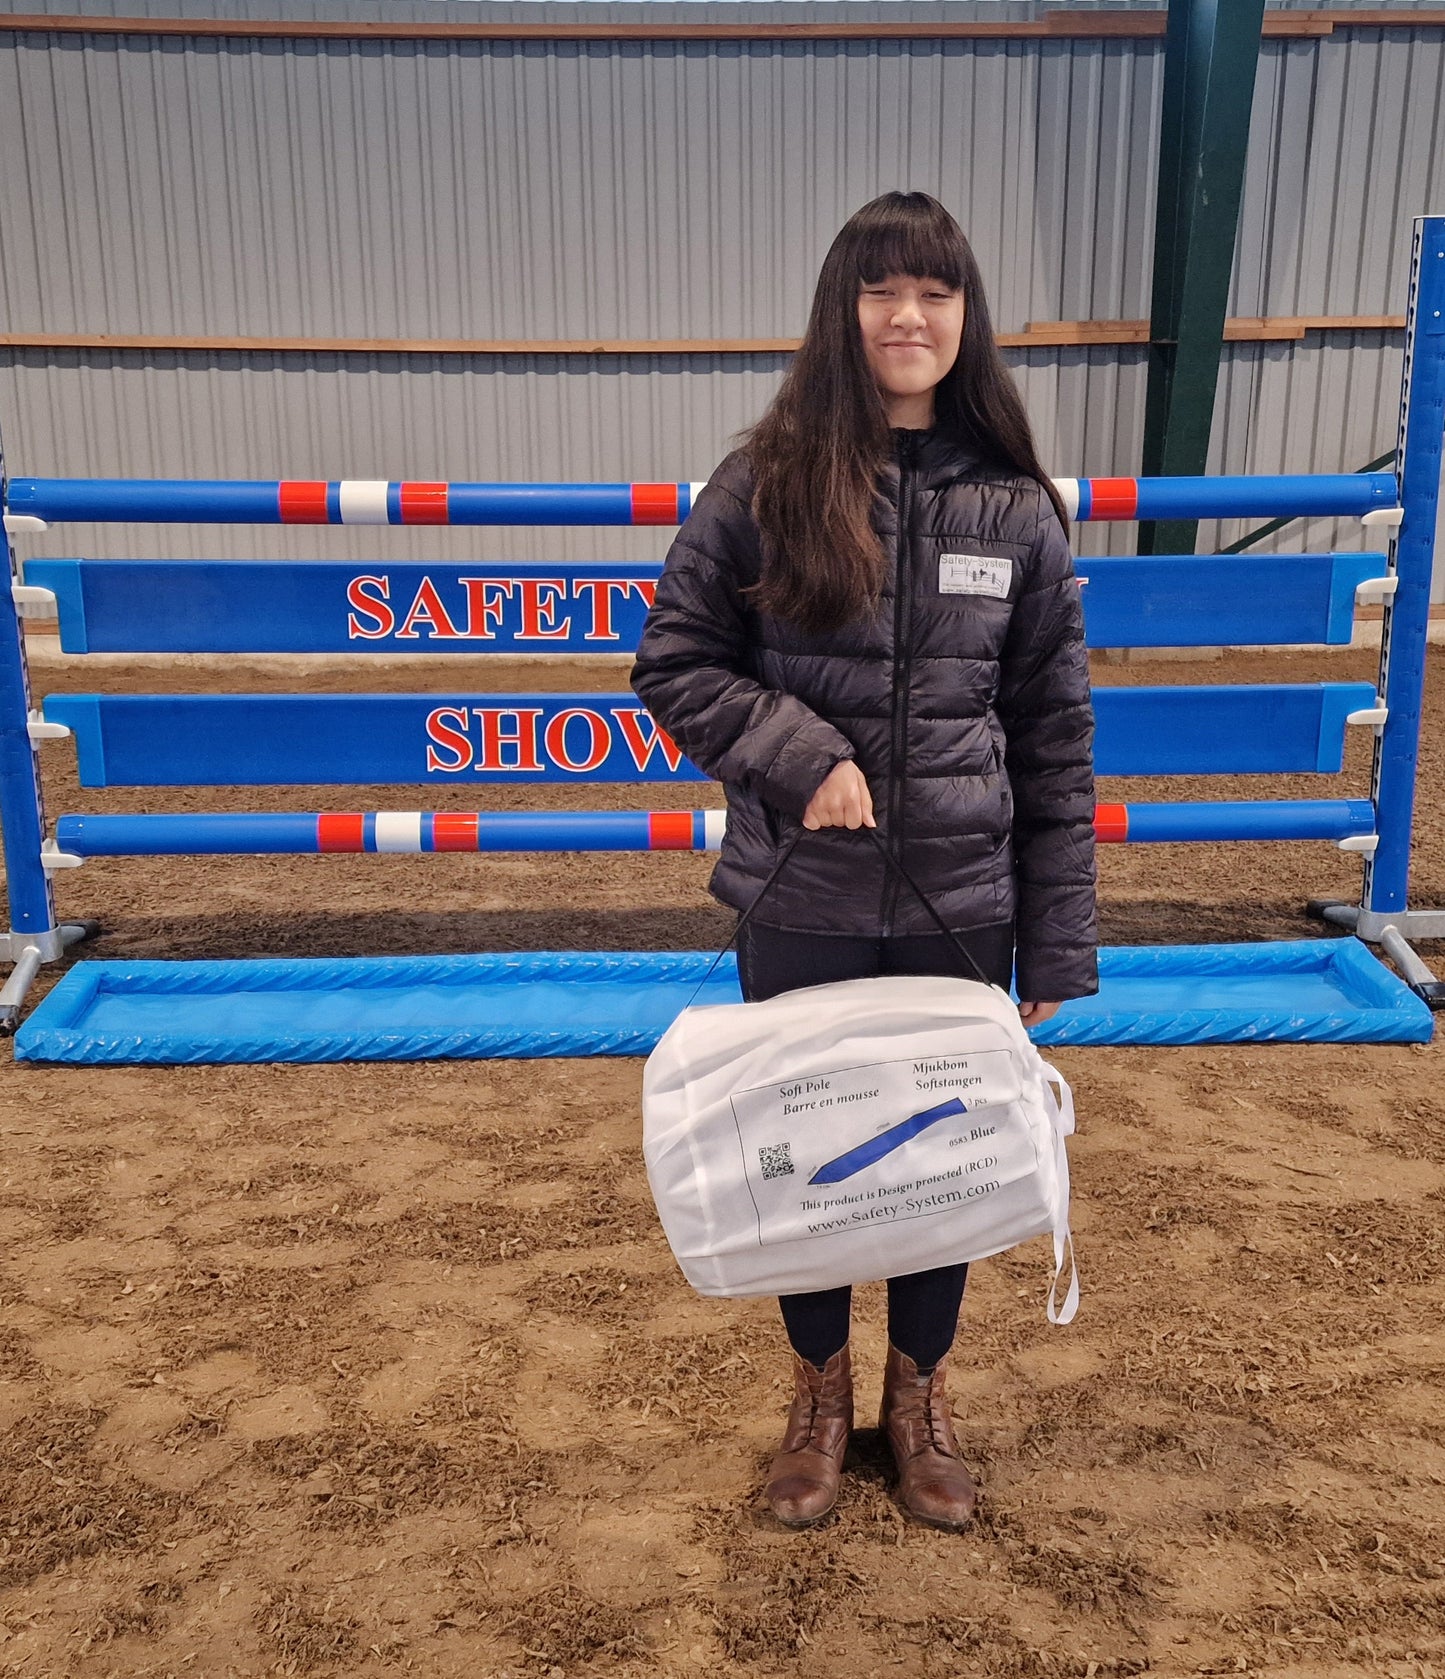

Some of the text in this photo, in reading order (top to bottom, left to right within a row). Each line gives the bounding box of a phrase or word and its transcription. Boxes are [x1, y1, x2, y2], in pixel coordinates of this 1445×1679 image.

[913, 1060, 968, 1076] Mjukbom
[779, 1079, 831, 1099] Soft Pole
[915, 1076, 982, 1092] Softstangen
[783, 1088, 880, 1116] Barre en mousse
[970, 1126, 996, 1141] Blue
[800, 1155, 998, 1211] This product is Design protected (RCD)
[807, 1179, 1000, 1234] www.Safety-System.com
